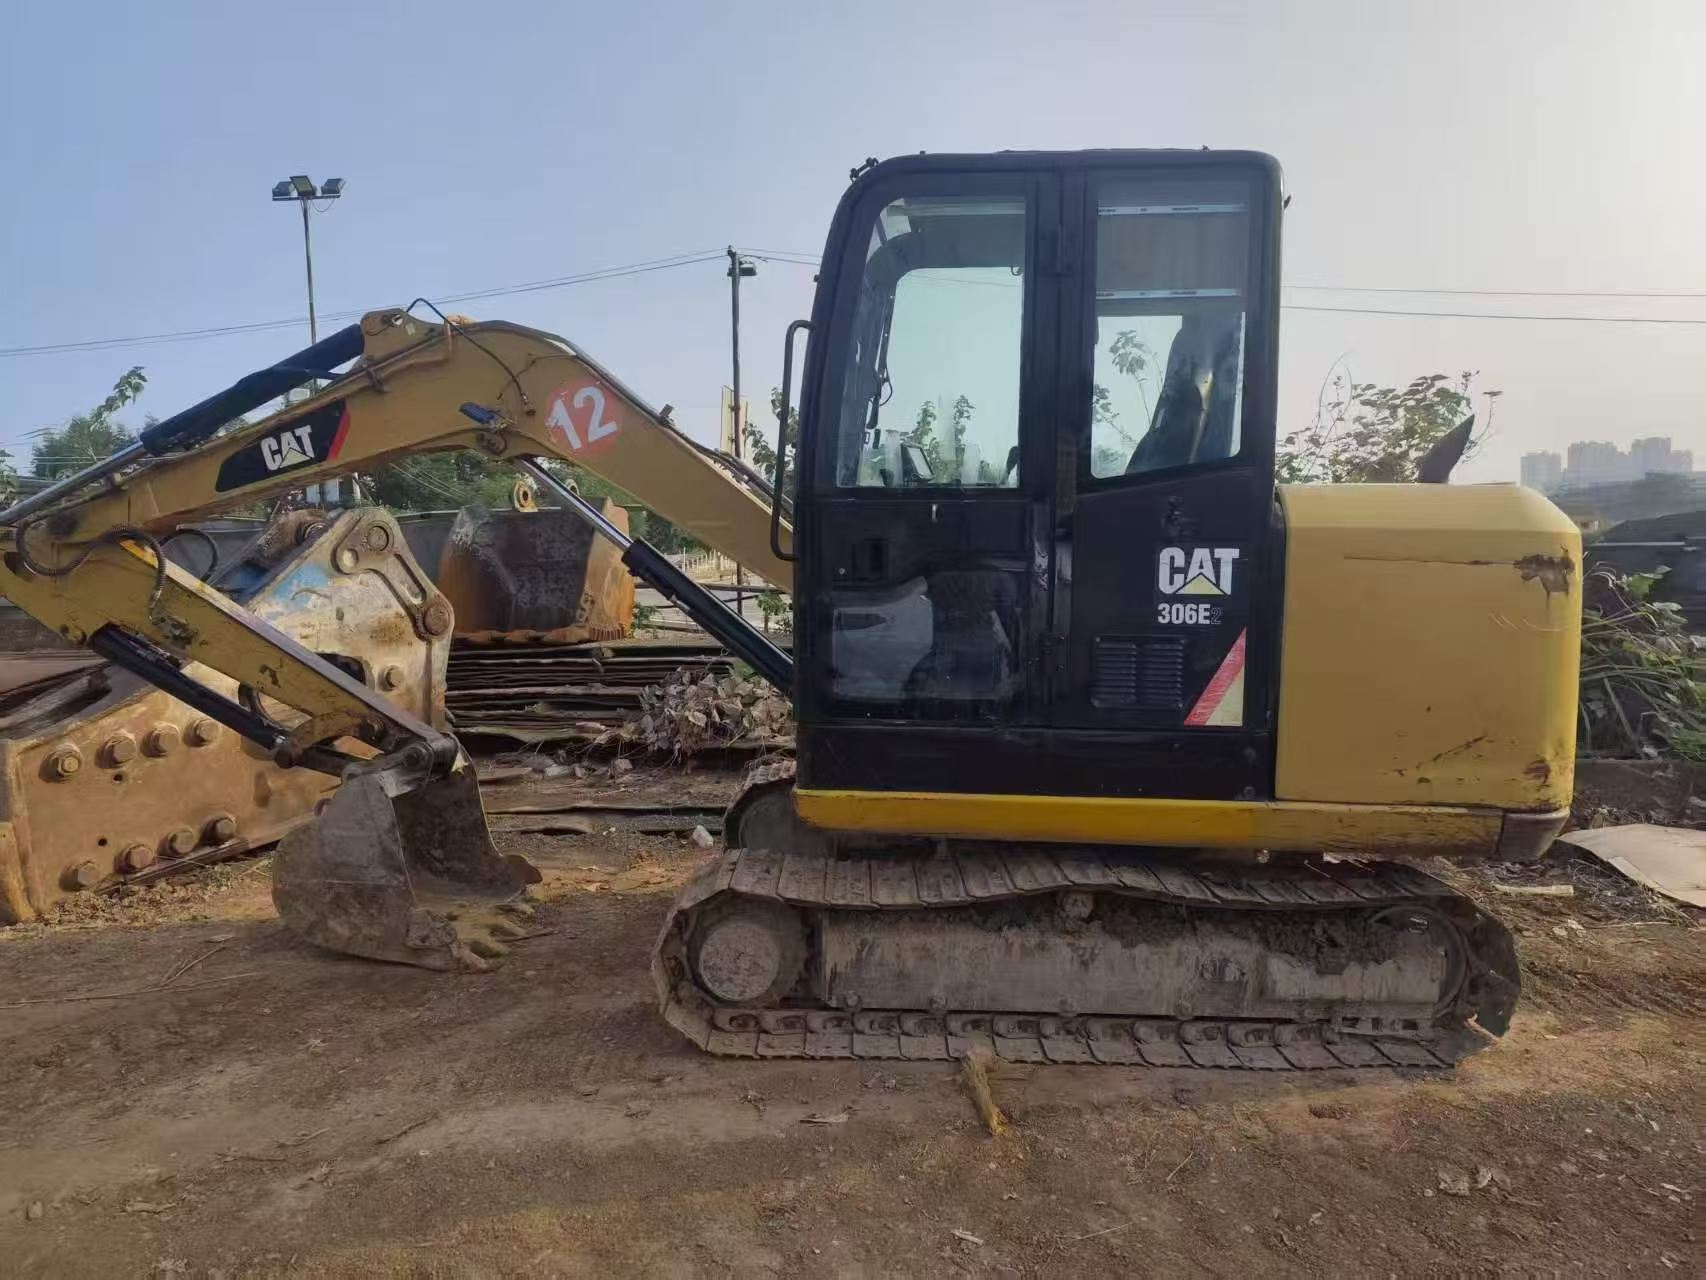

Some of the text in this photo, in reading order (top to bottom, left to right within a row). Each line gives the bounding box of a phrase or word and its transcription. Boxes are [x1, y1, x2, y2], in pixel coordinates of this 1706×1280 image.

[547, 386, 618, 450] 12
[260, 424, 316, 471] CAT
[1158, 546, 1240, 595] CAT
[1157, 603, 1222, 625] 306E2
